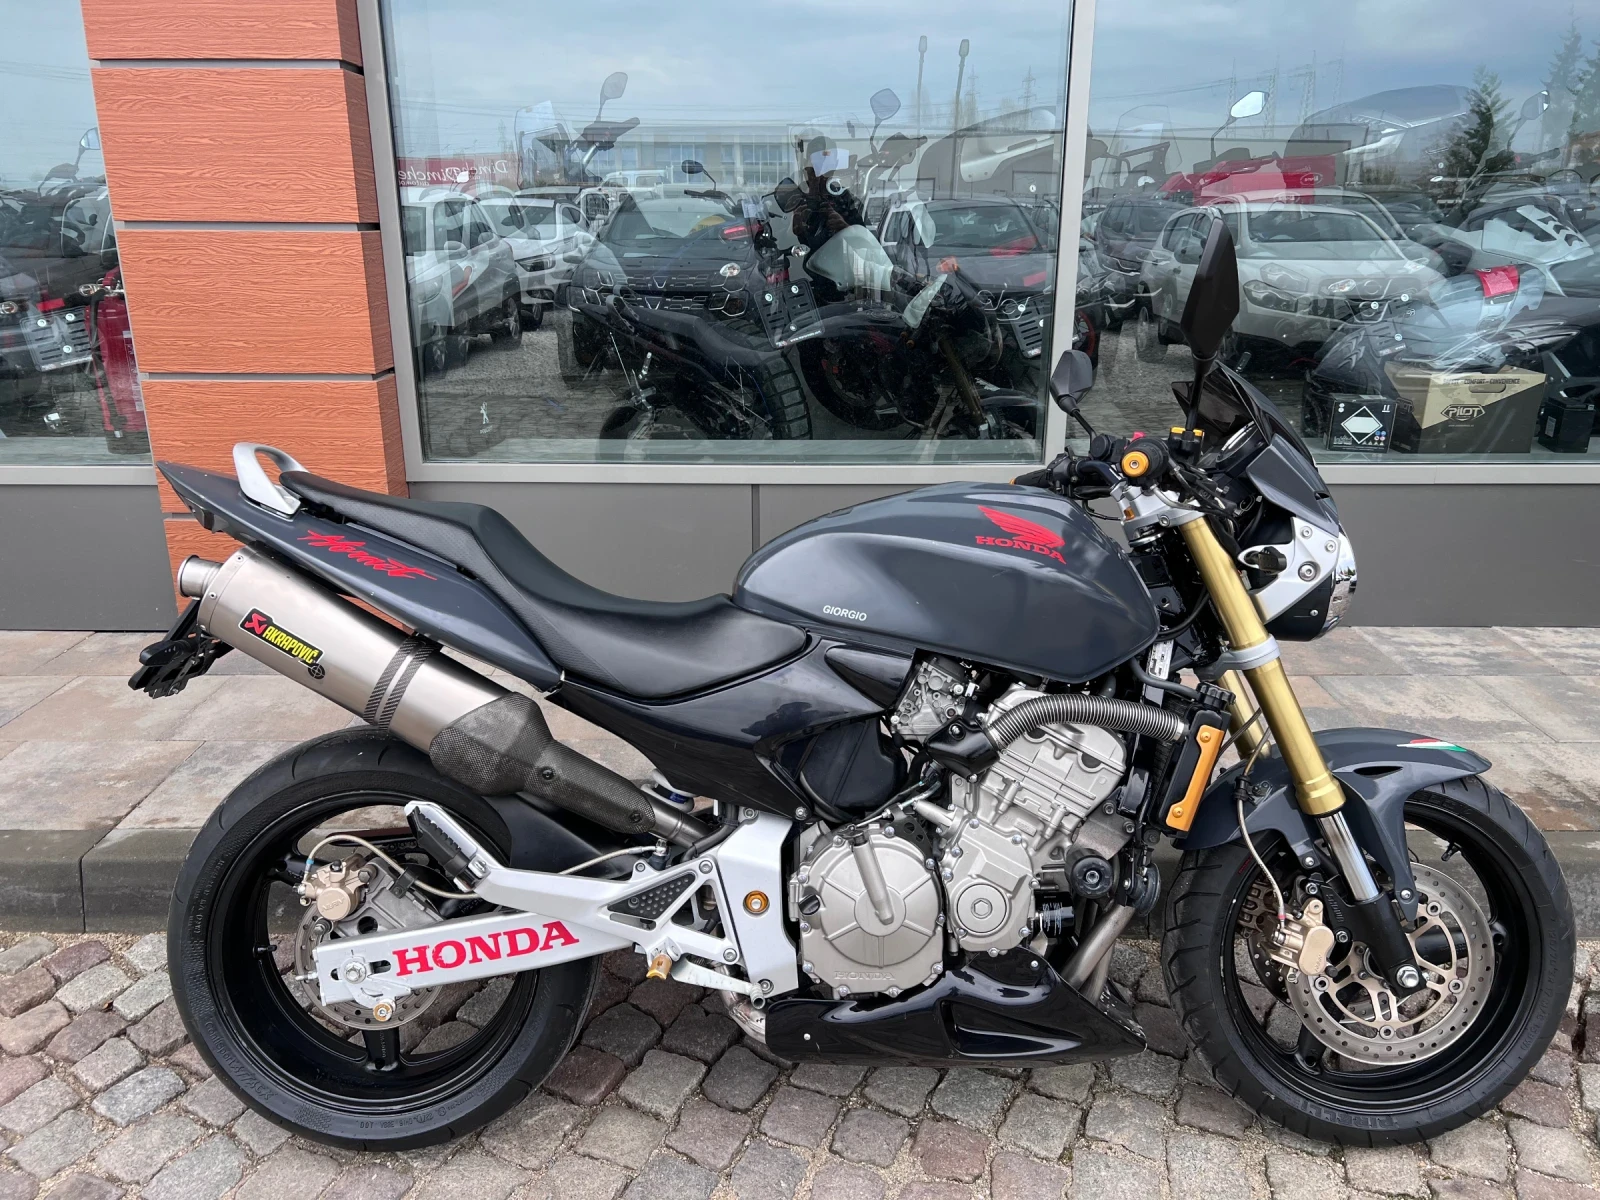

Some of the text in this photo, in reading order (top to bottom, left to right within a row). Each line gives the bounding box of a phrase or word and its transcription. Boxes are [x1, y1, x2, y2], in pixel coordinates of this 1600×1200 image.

[297, 530, 437, 580] Hornet
[975, 535, 1067, 565] HONDA
[822, 604, 867, 621] GIORGIO
[393, 920, 580, 976] HONDA
[834, 971, 896, 980] HONDA
